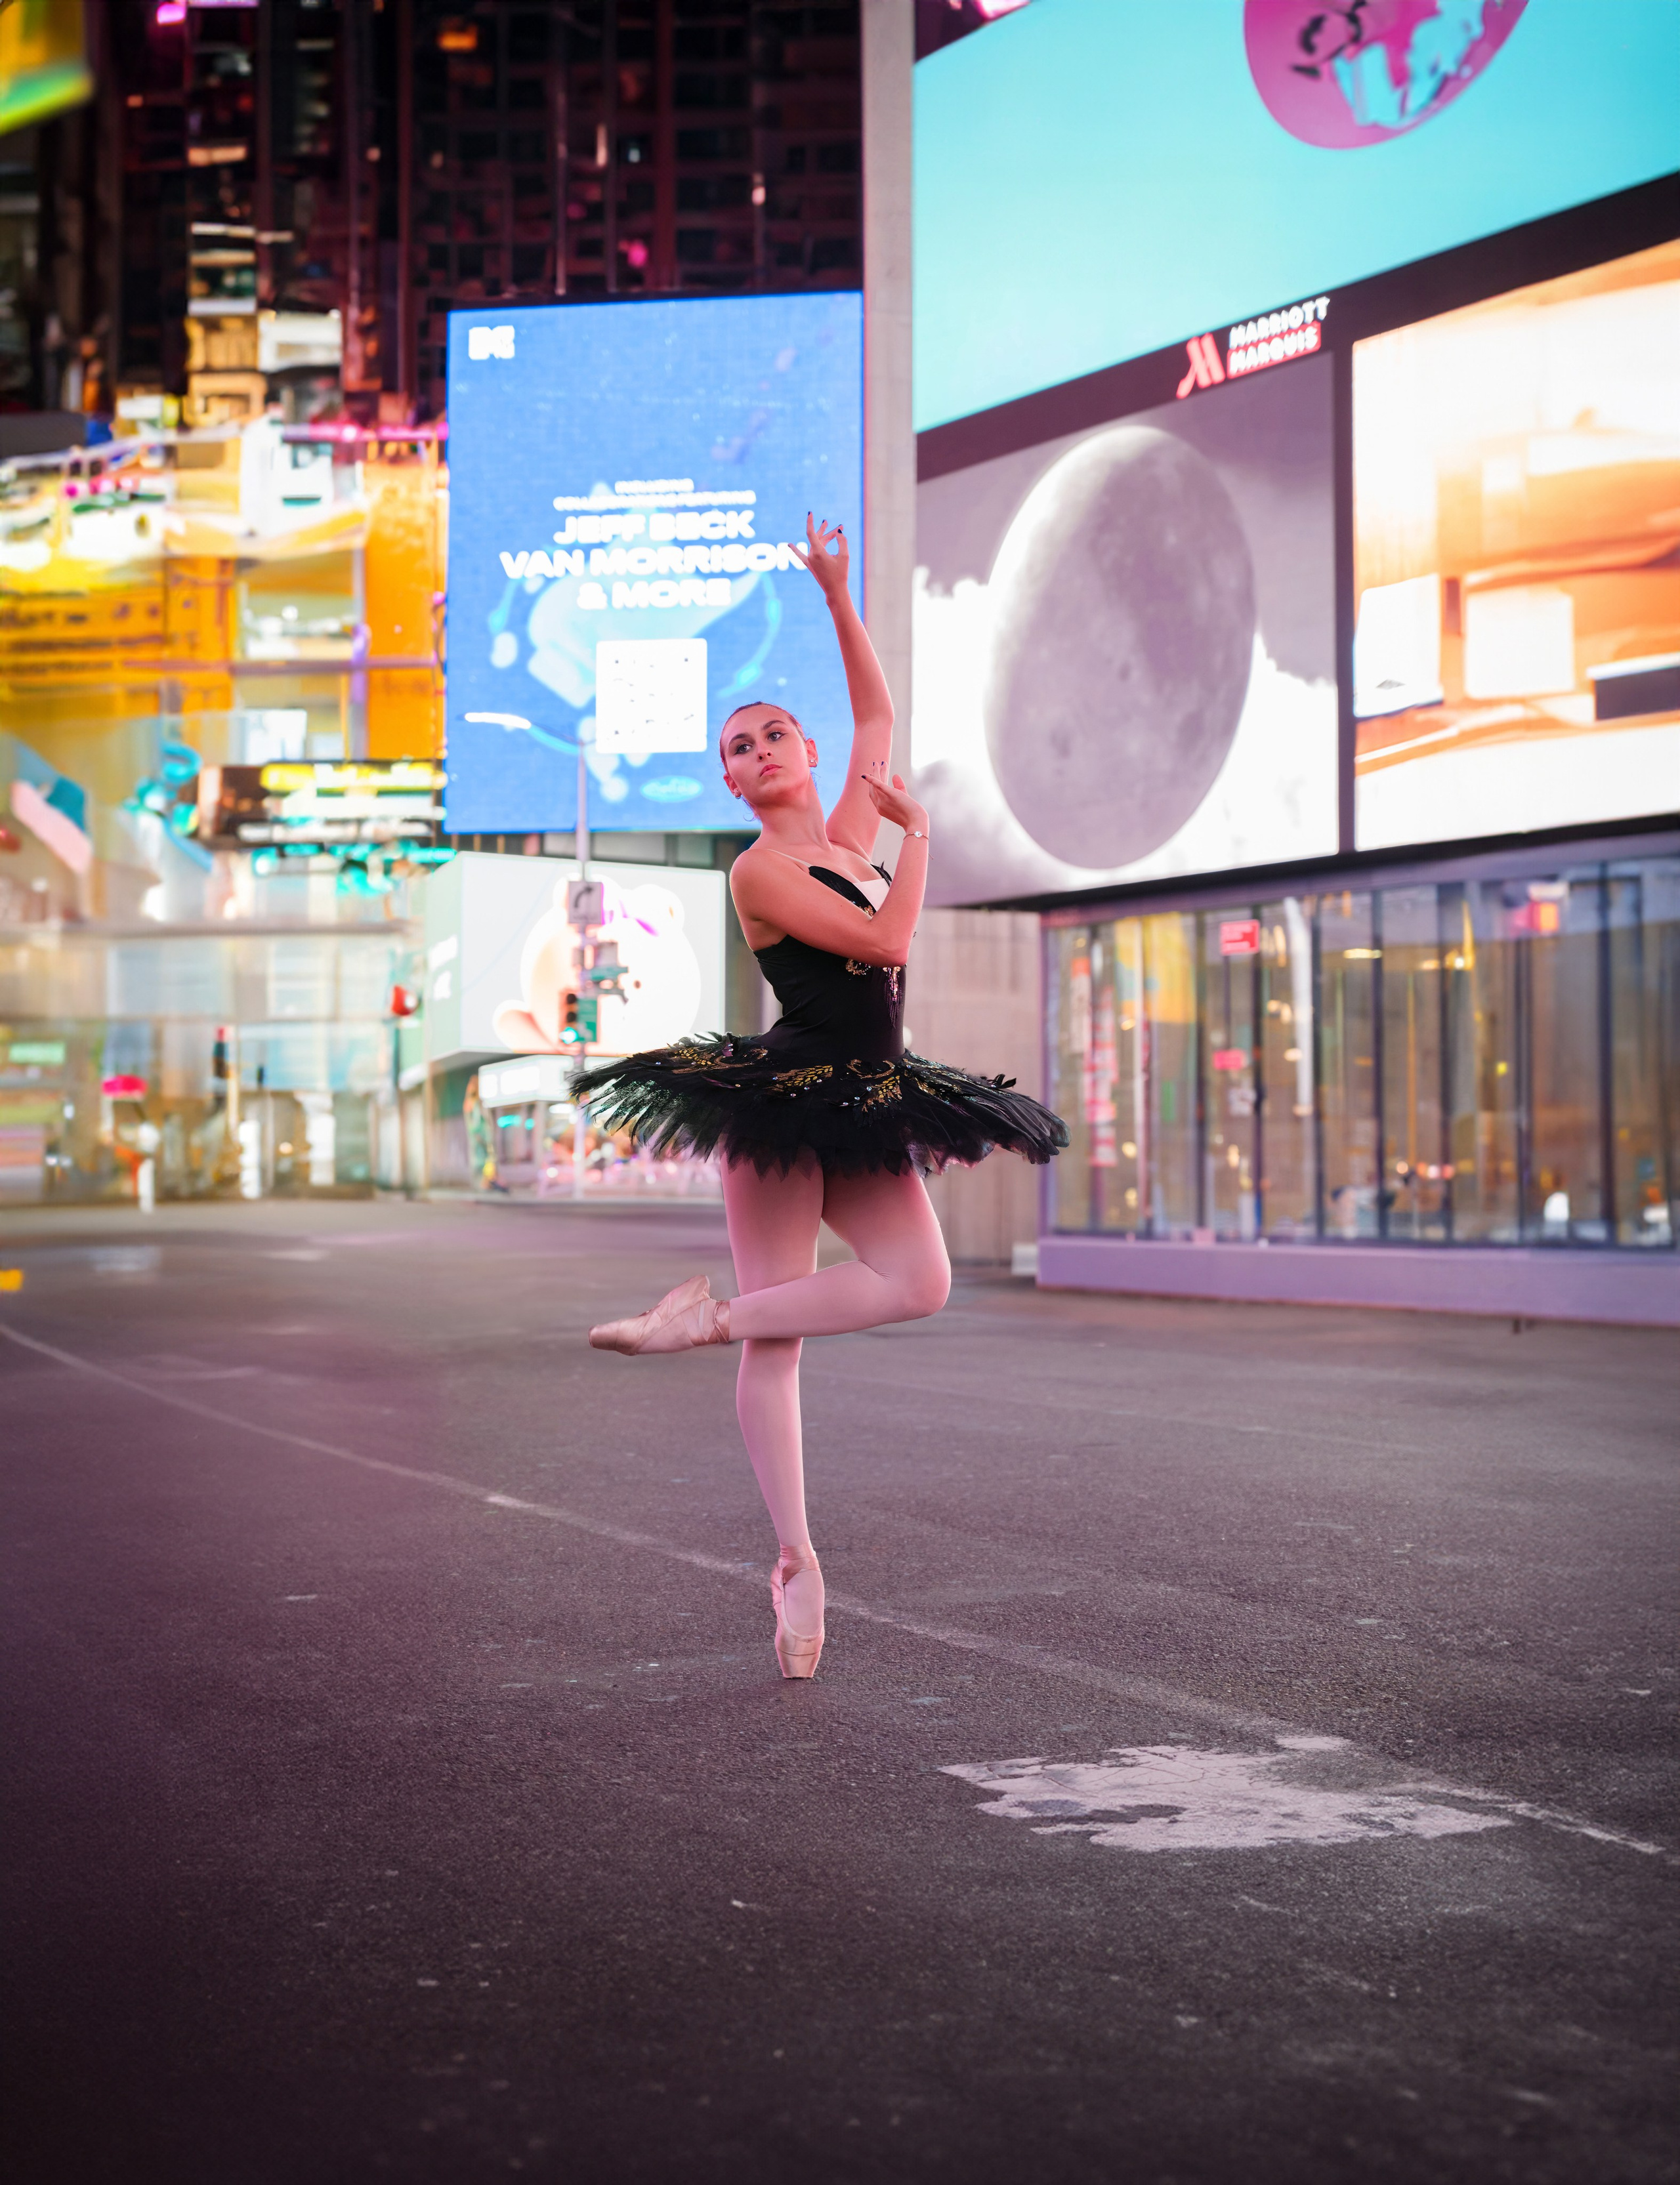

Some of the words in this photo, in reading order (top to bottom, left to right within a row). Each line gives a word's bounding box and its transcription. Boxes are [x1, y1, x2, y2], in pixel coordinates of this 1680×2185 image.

[1229, 296, 1330, 348] MARRIOTT
[1229, 325, 1318, 375] MARQUIS
[553, 514, 646, 544] JEFF
[649, 510, 755, 541] BECK
[499, 550, 585, 579] VAN
[590, 542, 808, 575] MORRISON
[576, 582, 607, 610] &
[612, 579, 732, 608] MORE
